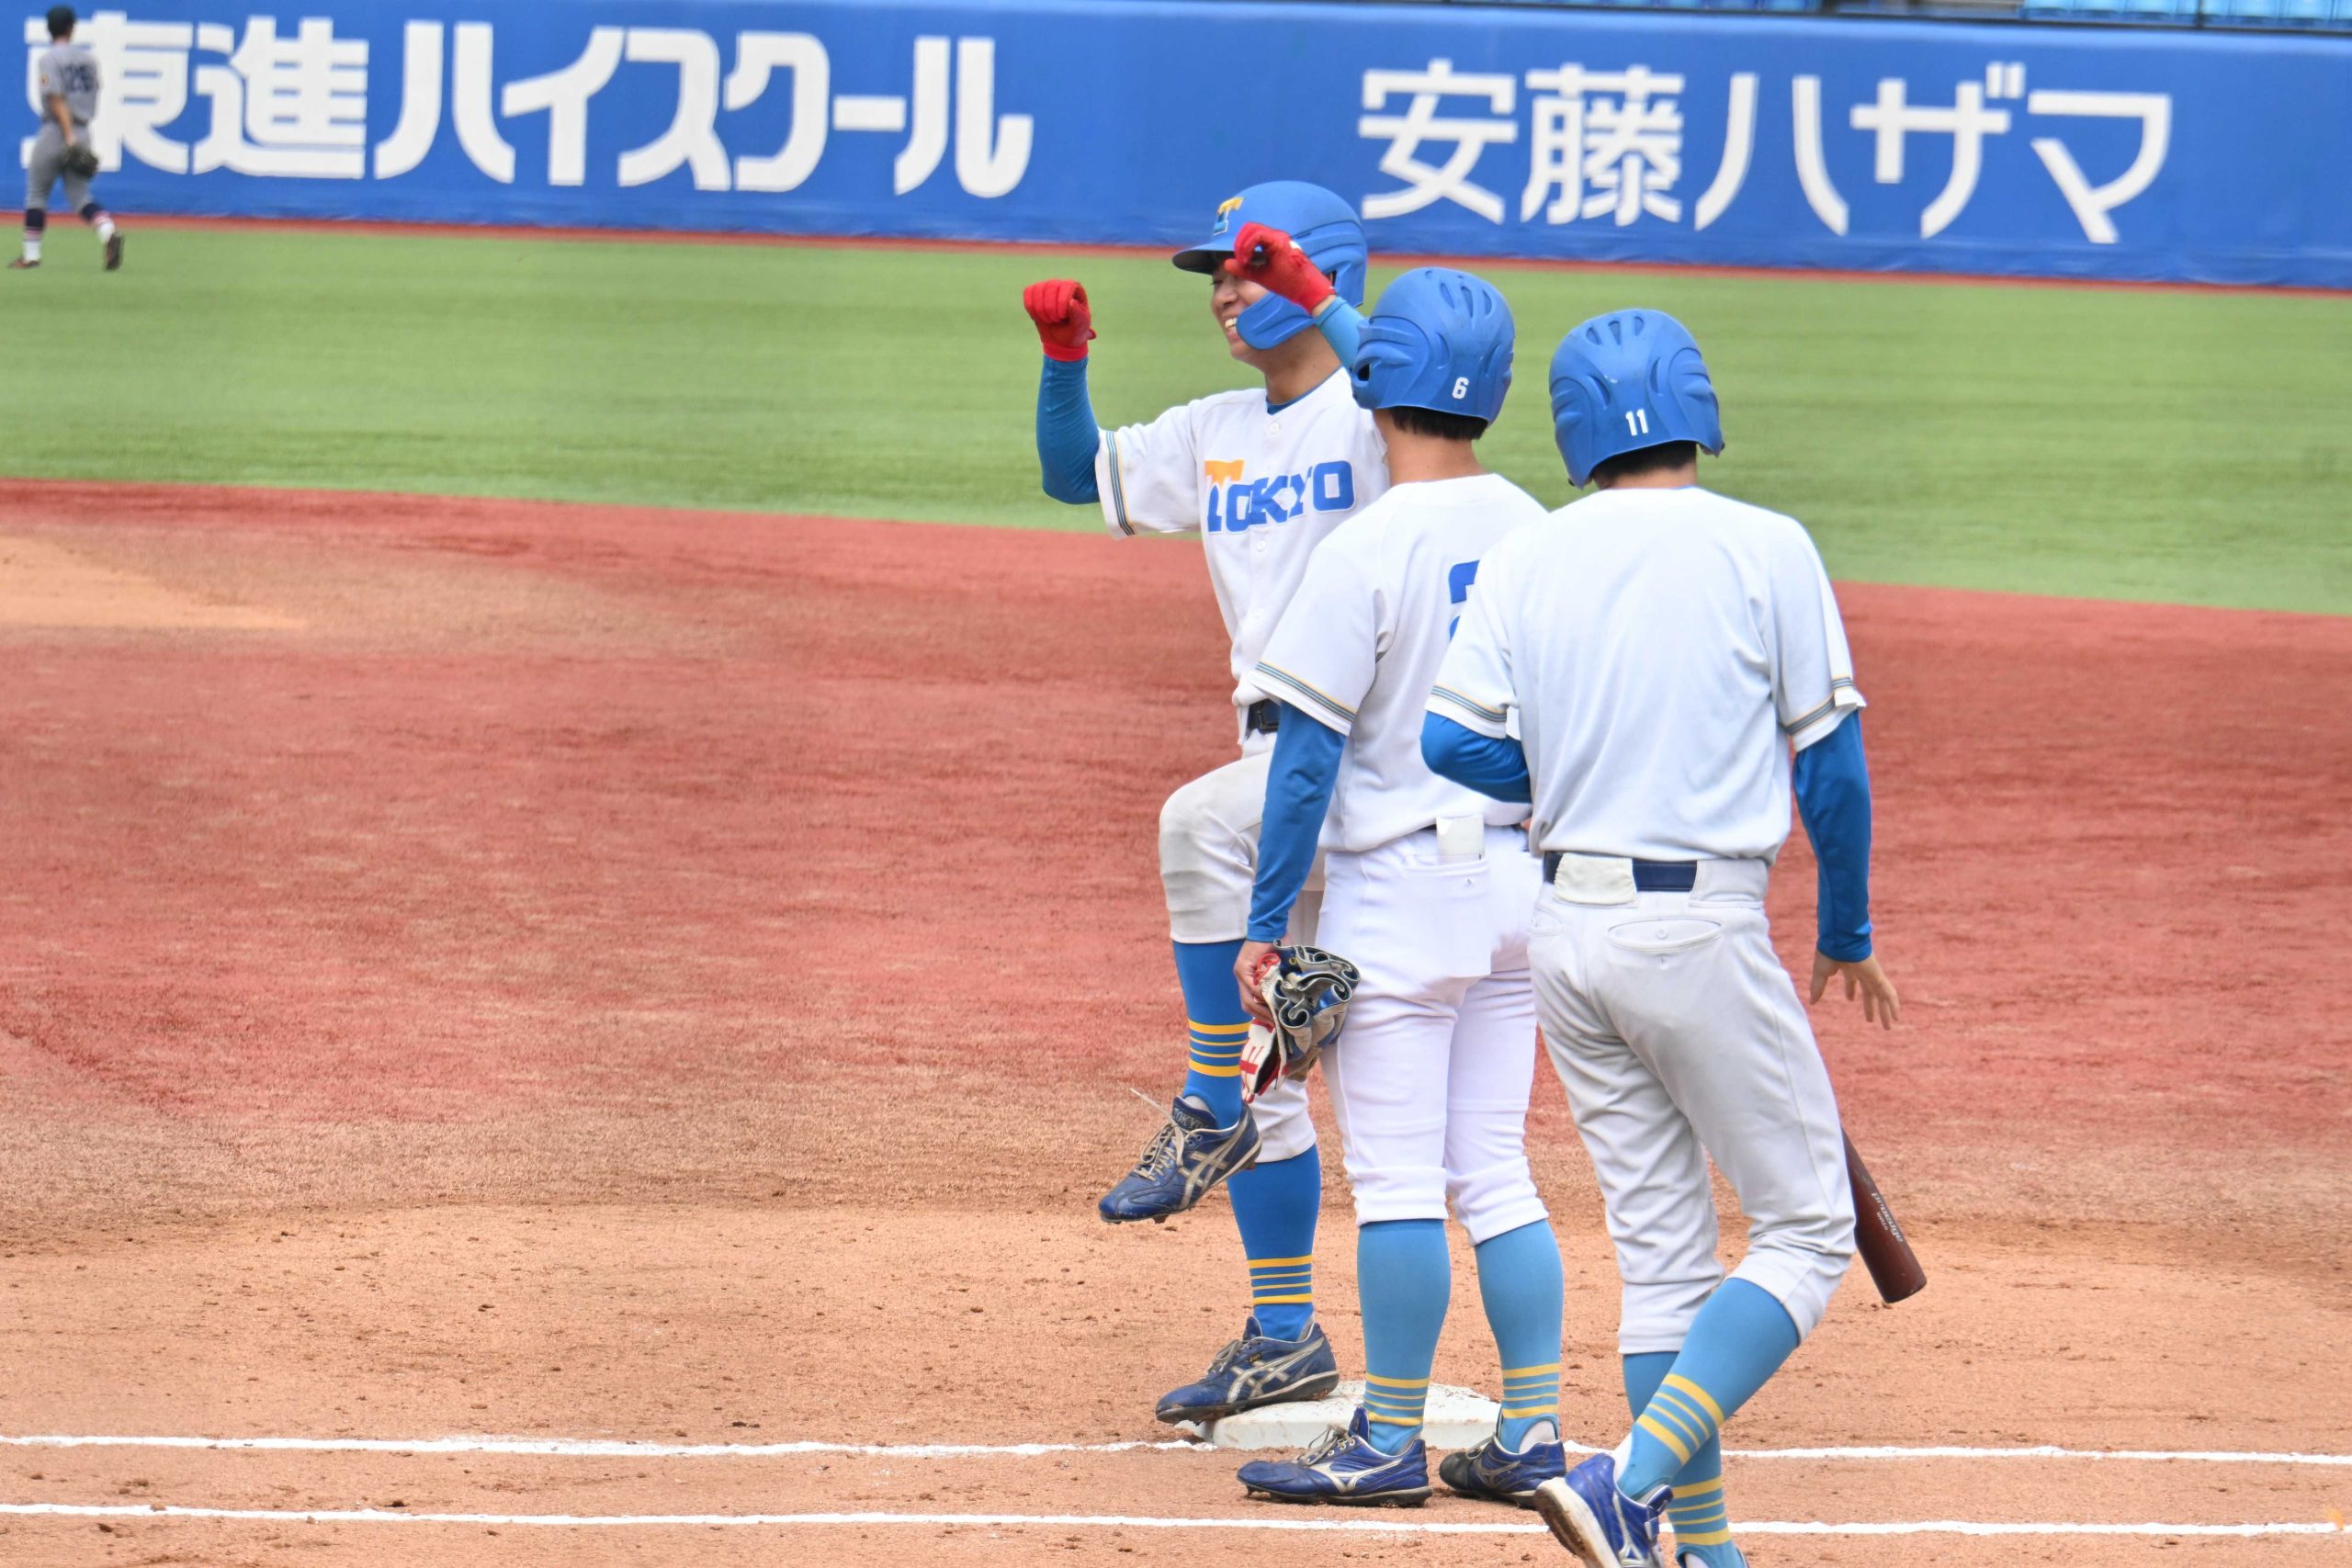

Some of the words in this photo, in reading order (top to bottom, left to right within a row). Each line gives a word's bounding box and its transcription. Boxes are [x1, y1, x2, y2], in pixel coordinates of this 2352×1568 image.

[21, 10, 1035, 198] 東進ハイスクール
[1358, 59, 2173, 244] 安藤ハザマ
[1453, 377, 1469, 400] 6
[1625, 409, 1649, 436] 11
[1204, 459, 1355, 533] TOKYO
